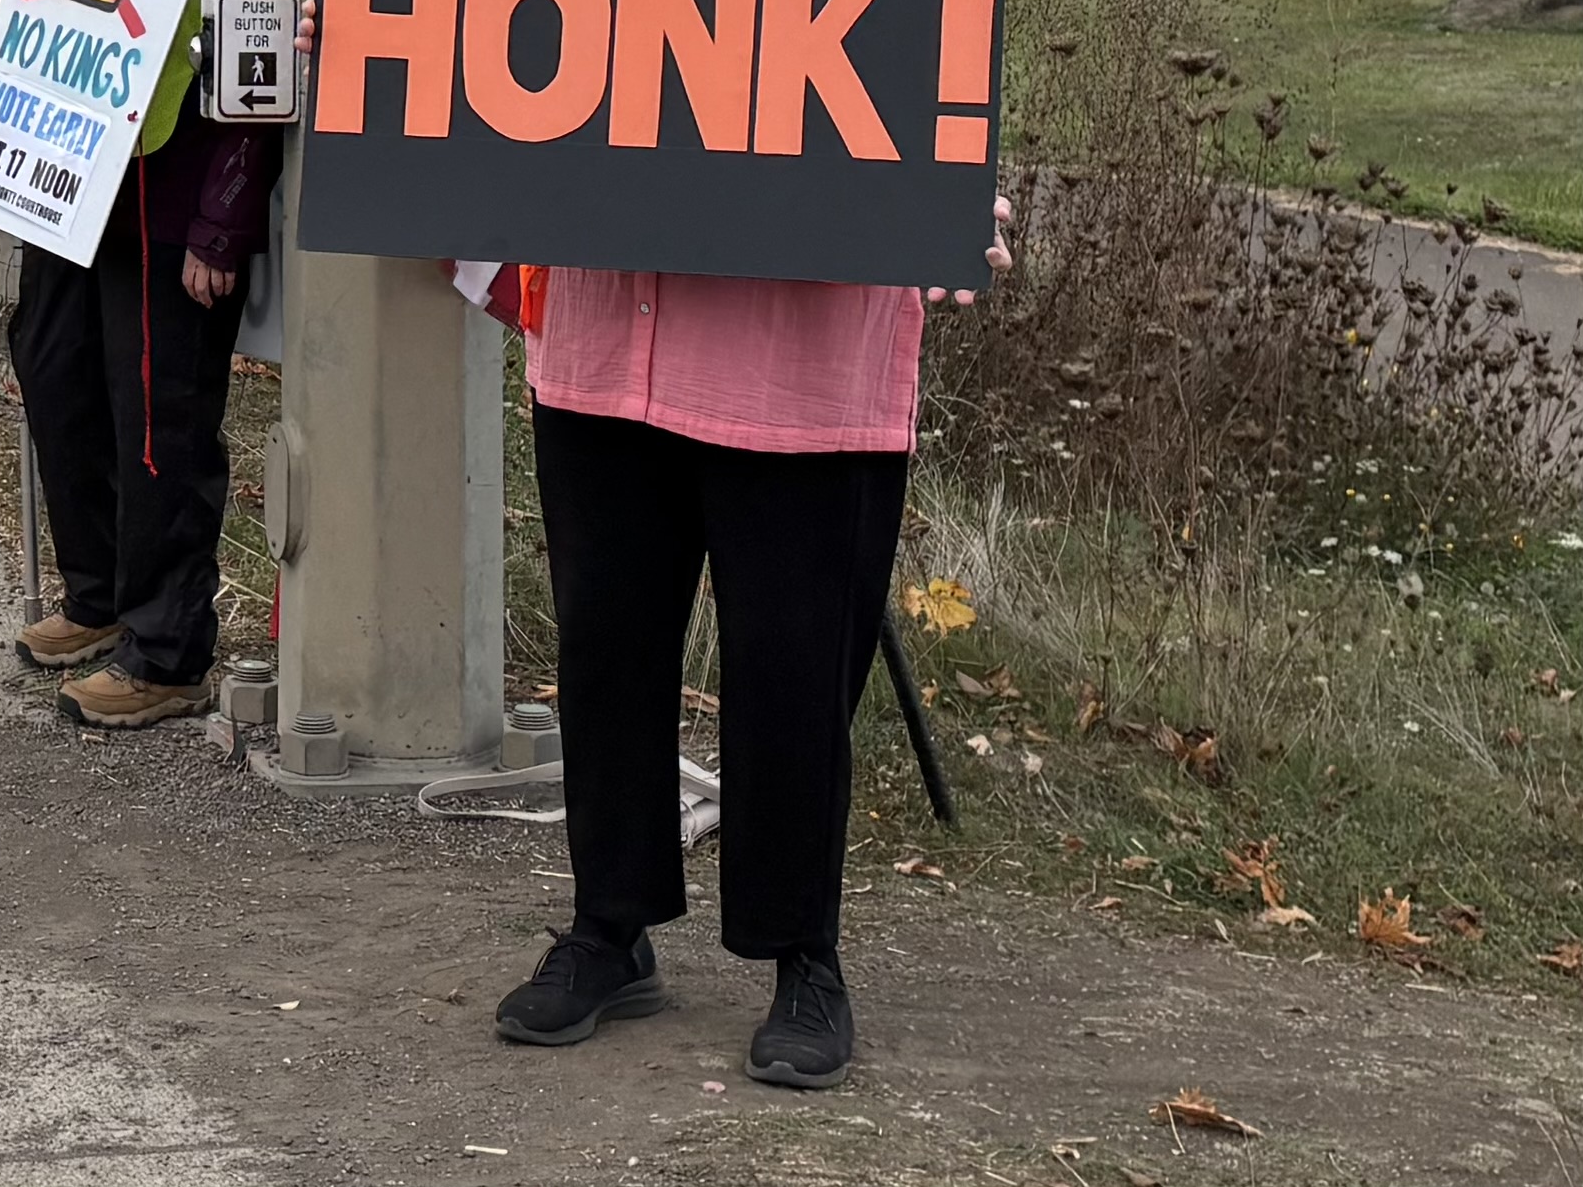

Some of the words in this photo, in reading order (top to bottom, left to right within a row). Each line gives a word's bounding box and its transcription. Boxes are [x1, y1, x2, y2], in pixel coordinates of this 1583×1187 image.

[234, 17, 281, 31] BUTTON
[242, 1, 274, 14] PUSH
[246, 35, 269, 48] FOR
[40, 24, 142, 108] KINGS
[34, 102, 106, 160] EARLY
[5, 148, 27, 179] 17
[29, 158, 82, 205] NOON
